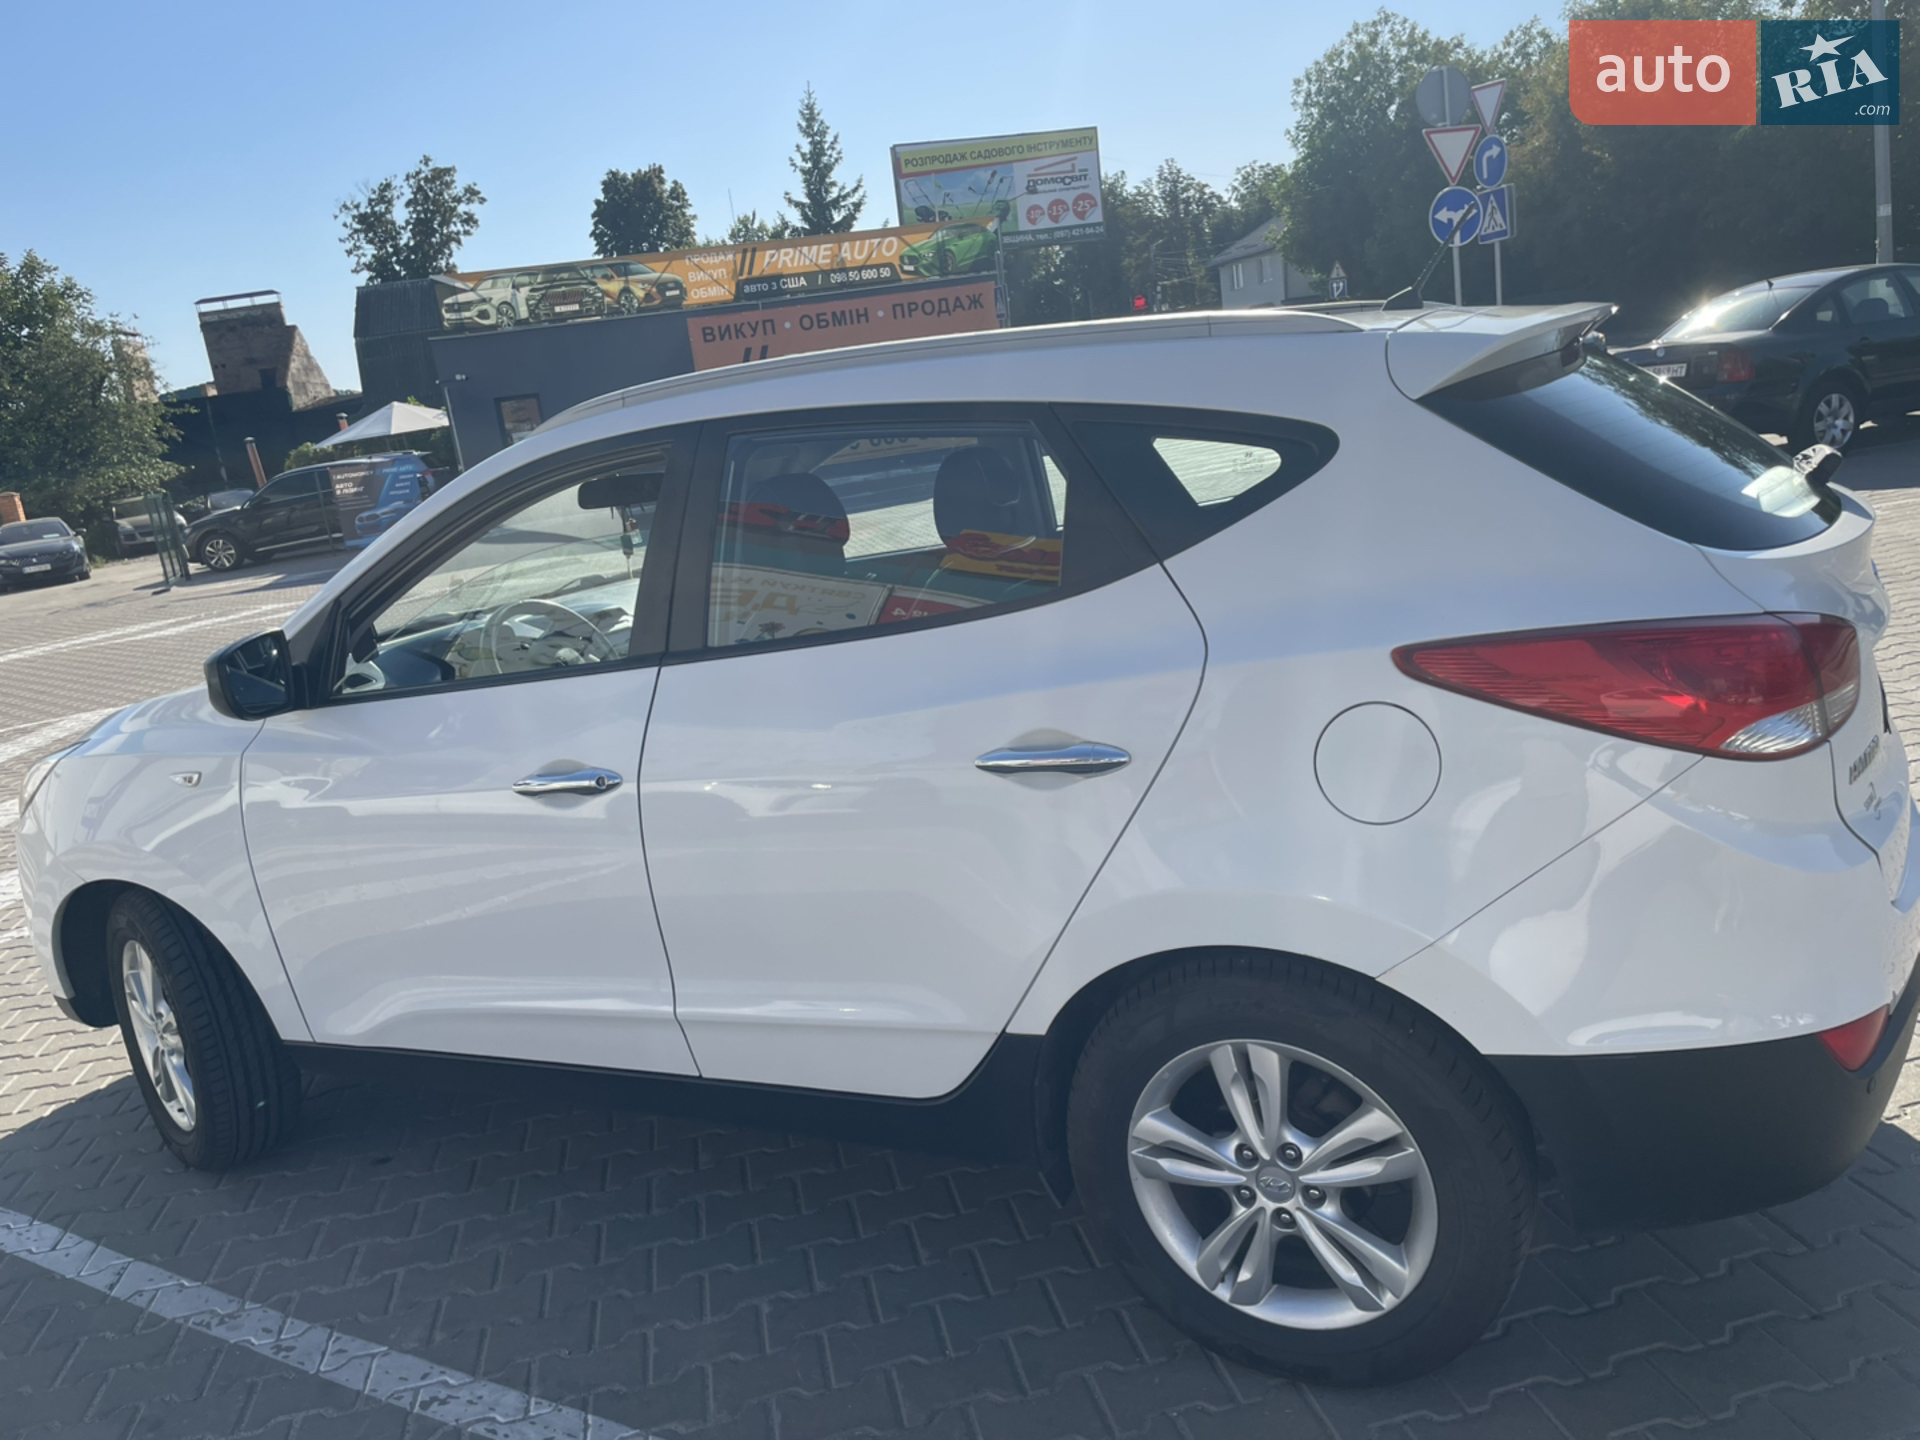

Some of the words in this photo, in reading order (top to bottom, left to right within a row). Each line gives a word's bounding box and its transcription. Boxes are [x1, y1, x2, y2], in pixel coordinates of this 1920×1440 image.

[904, 151, 968, 168] РОЗПРОДАЖ
[970, 145, 1025, 161] САДОВОГО
[1026, 135, 1095, 153] ІНСТРУМЕНТУ
[685, 250, 736, 266] ПРОДАЖ
[763, 244, 833, 270] PRIME
[836, 236, 898, 262] AUTO
[688, 267, 728, 283] ВИКУП
[743, 282, 769, 293] авто
[780, 276, 808, 289] США
[830, 270, 847, 284] 098
[848, 269, 860, 281] 50
[861, 268, 879, 280] 600
[879, 267, 891, 278] 50
[690, 284, 729, 300] ОБМІН
[701, 318, 777, 343] ВИКУП
[799, 307, 870, 332] ОБМІН
[891, 292, 985, 320] ПРОДАЖ
